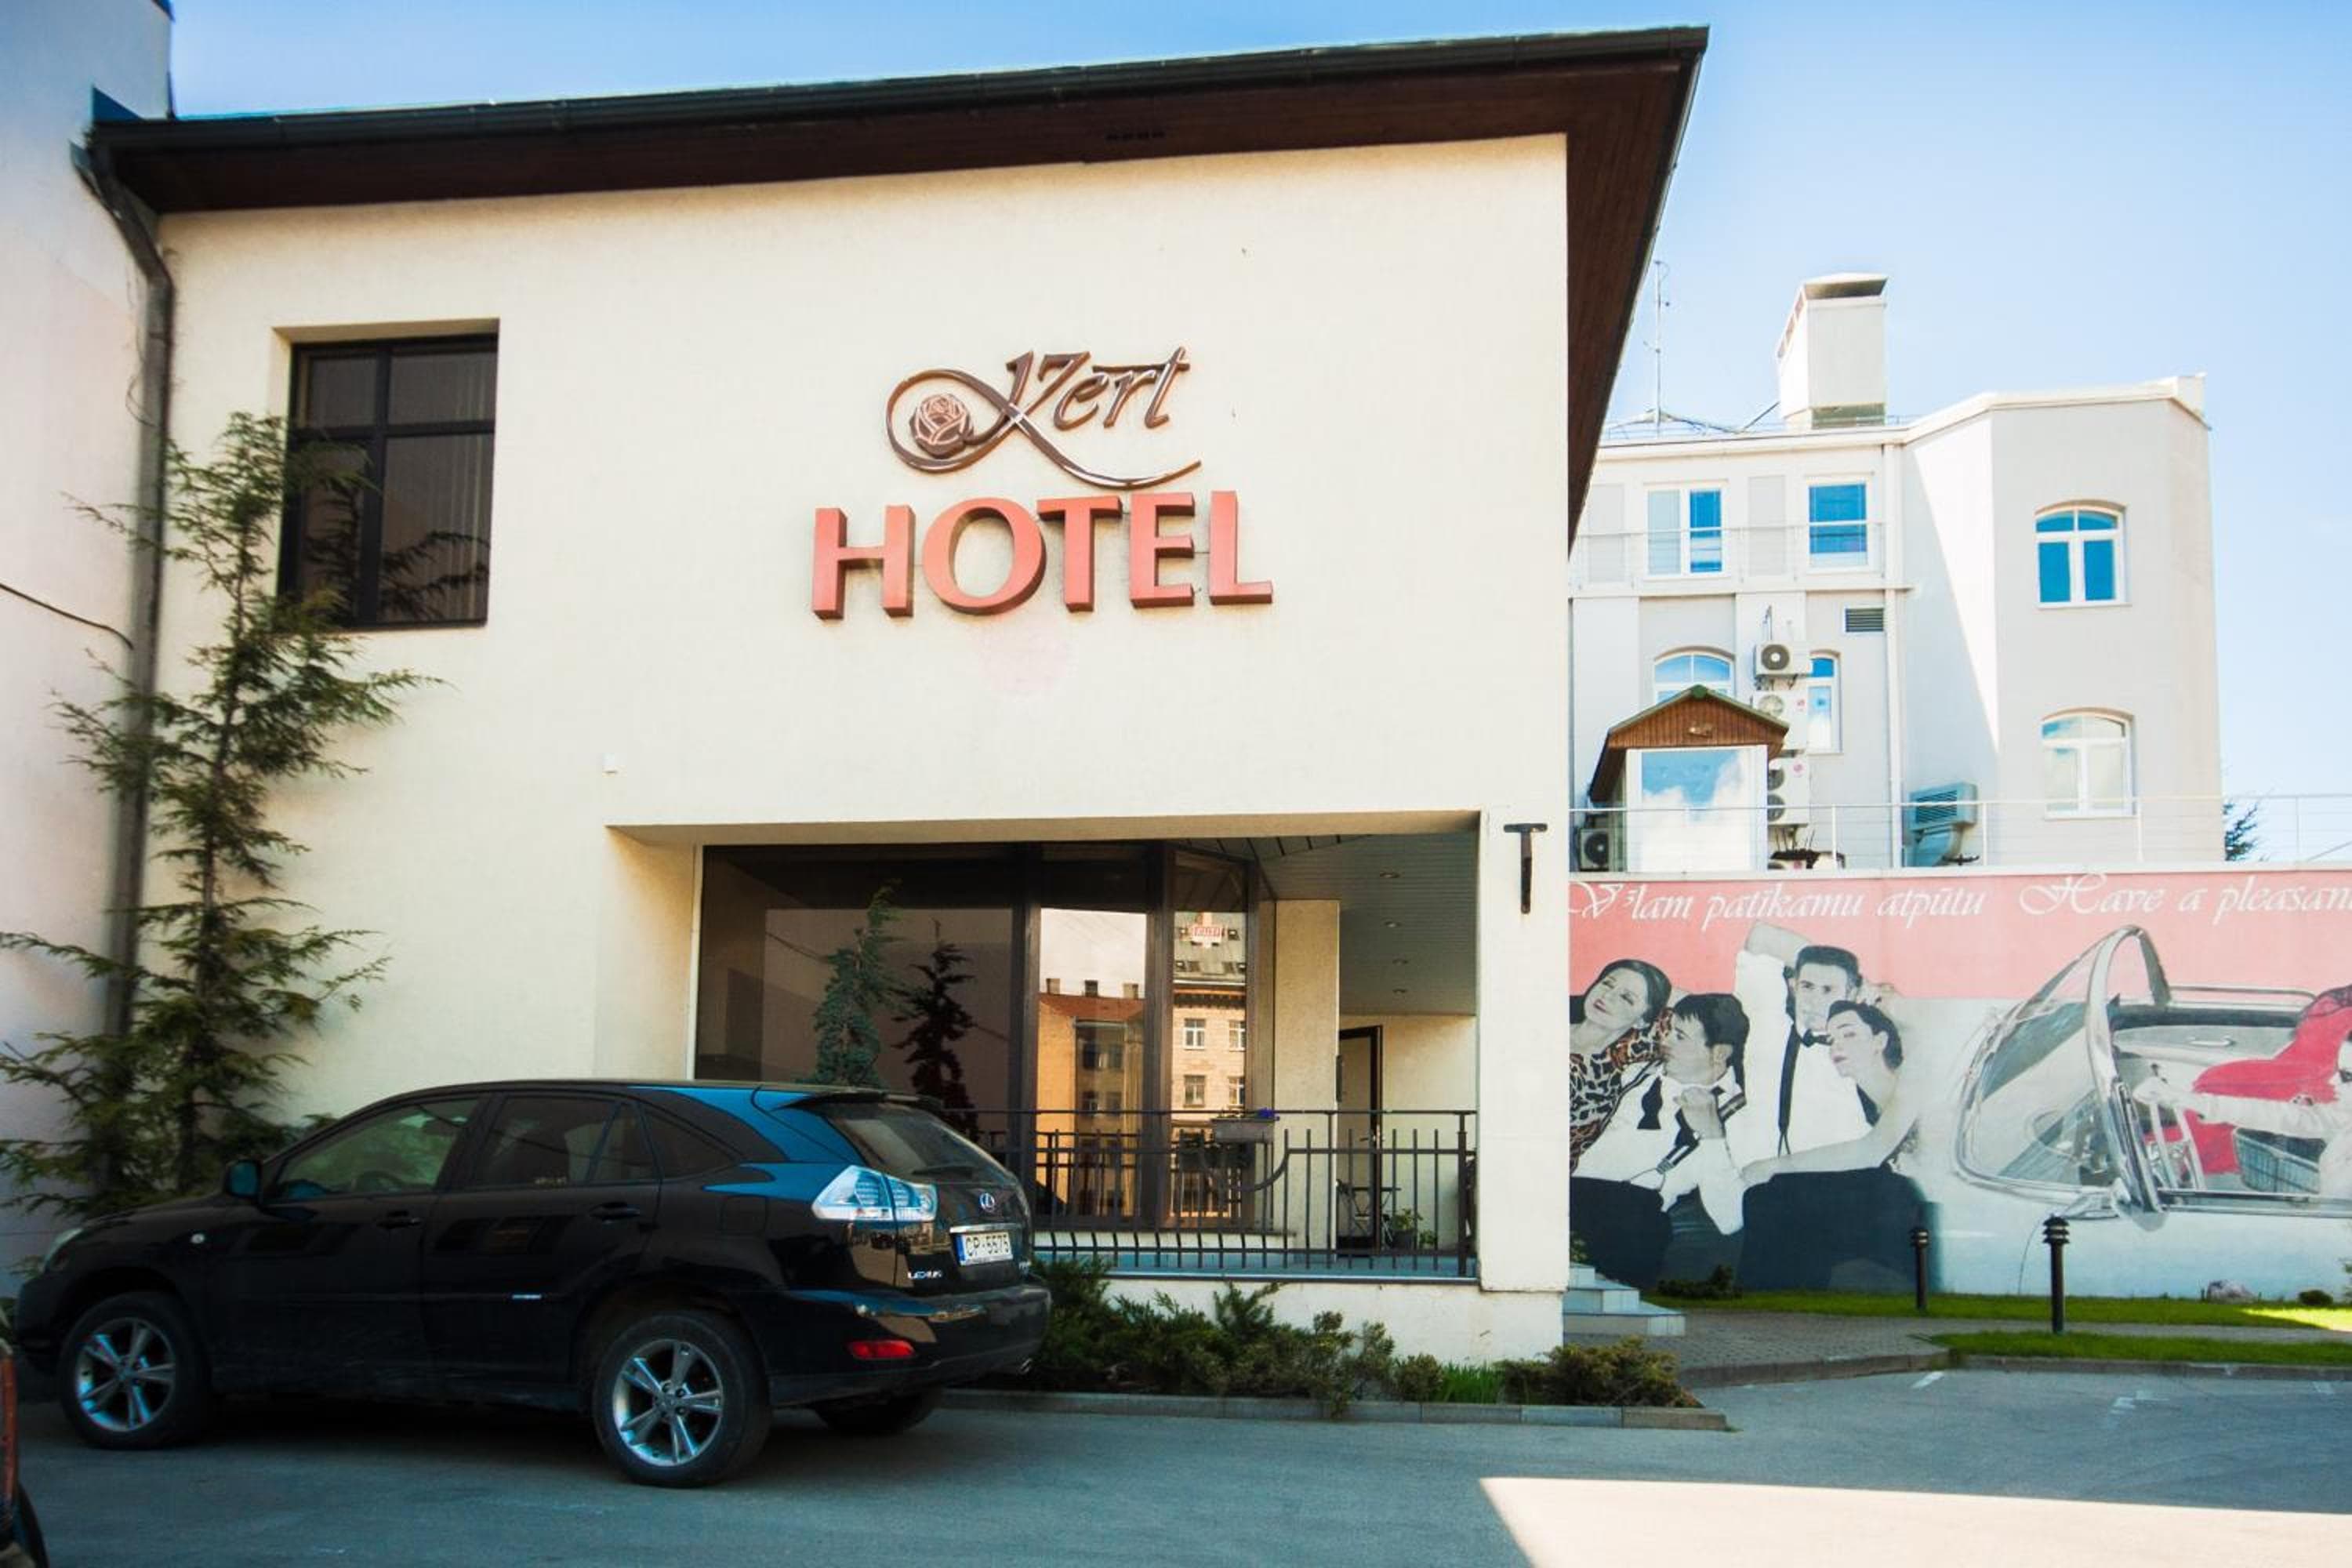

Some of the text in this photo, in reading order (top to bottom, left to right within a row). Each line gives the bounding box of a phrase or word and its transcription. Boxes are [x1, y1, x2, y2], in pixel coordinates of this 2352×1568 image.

[812, 490, 1273, 620] HOTEL
[2019, 873, 2352, 926] Have a pleasan
